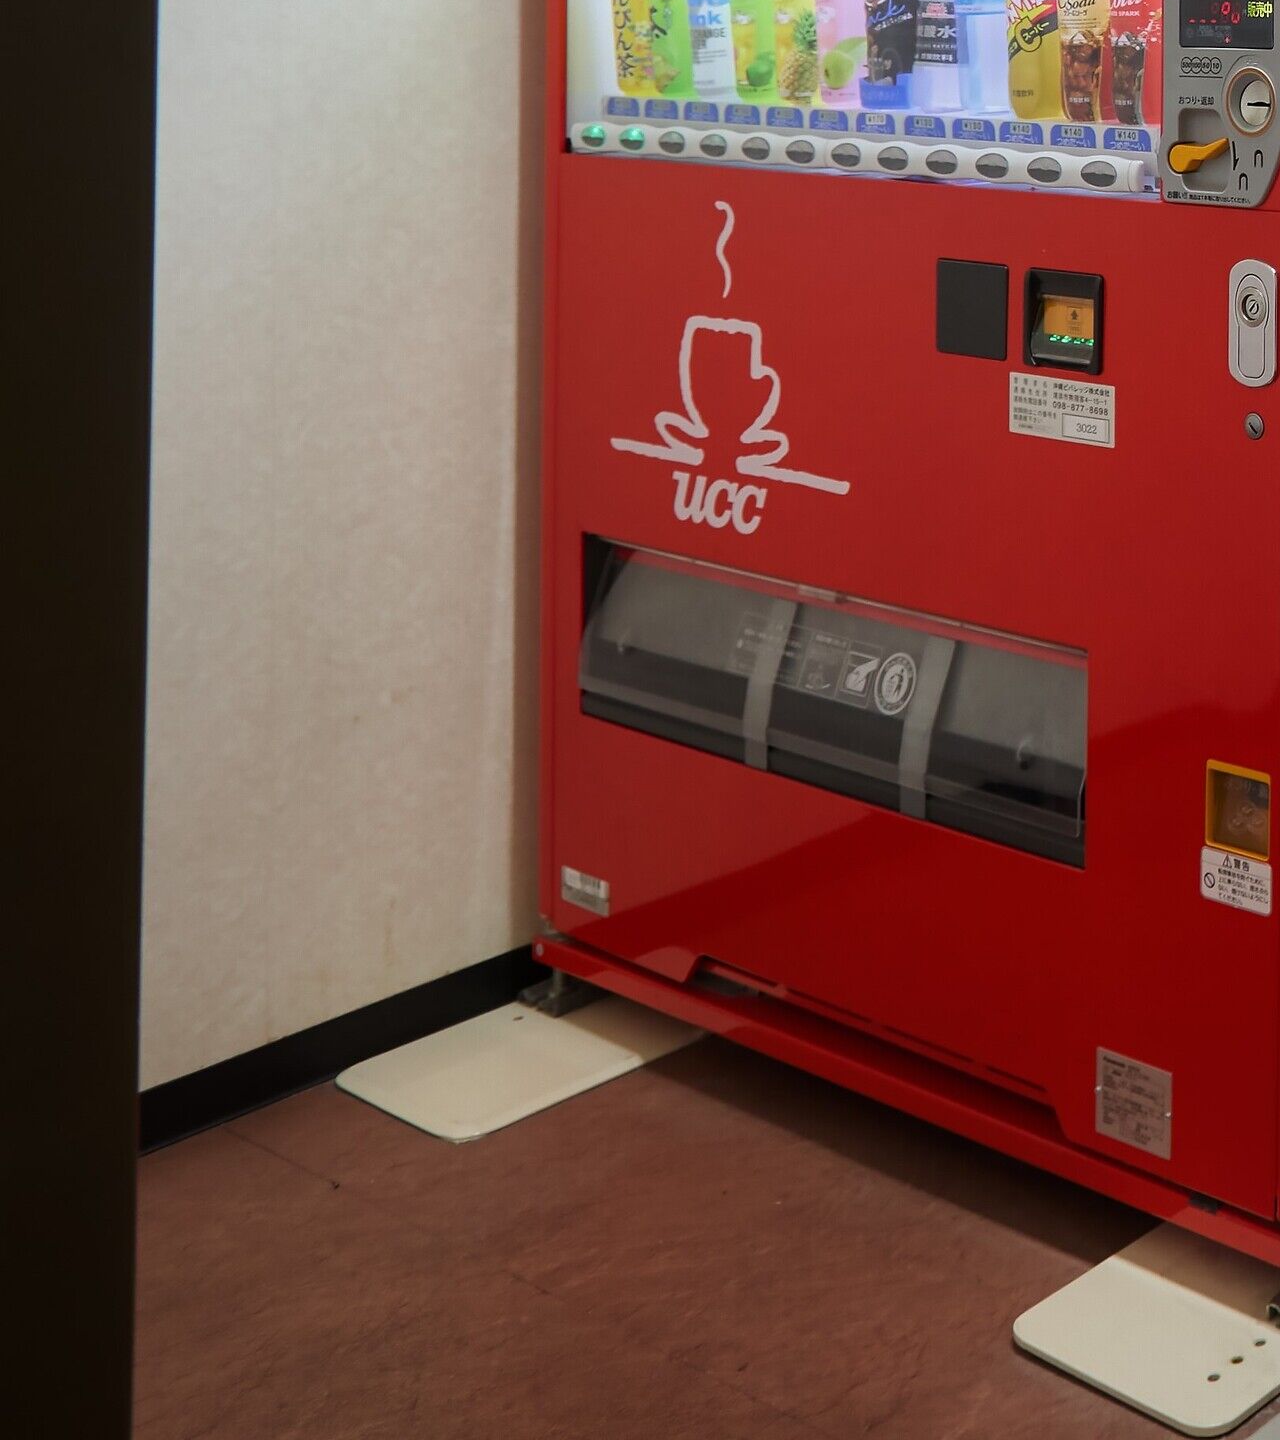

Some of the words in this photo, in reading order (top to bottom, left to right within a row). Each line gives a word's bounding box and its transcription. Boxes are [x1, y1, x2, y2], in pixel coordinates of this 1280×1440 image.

[1247, 1, 1273, 17] 販売中
[1076, 423, 1098, 435] 3022
